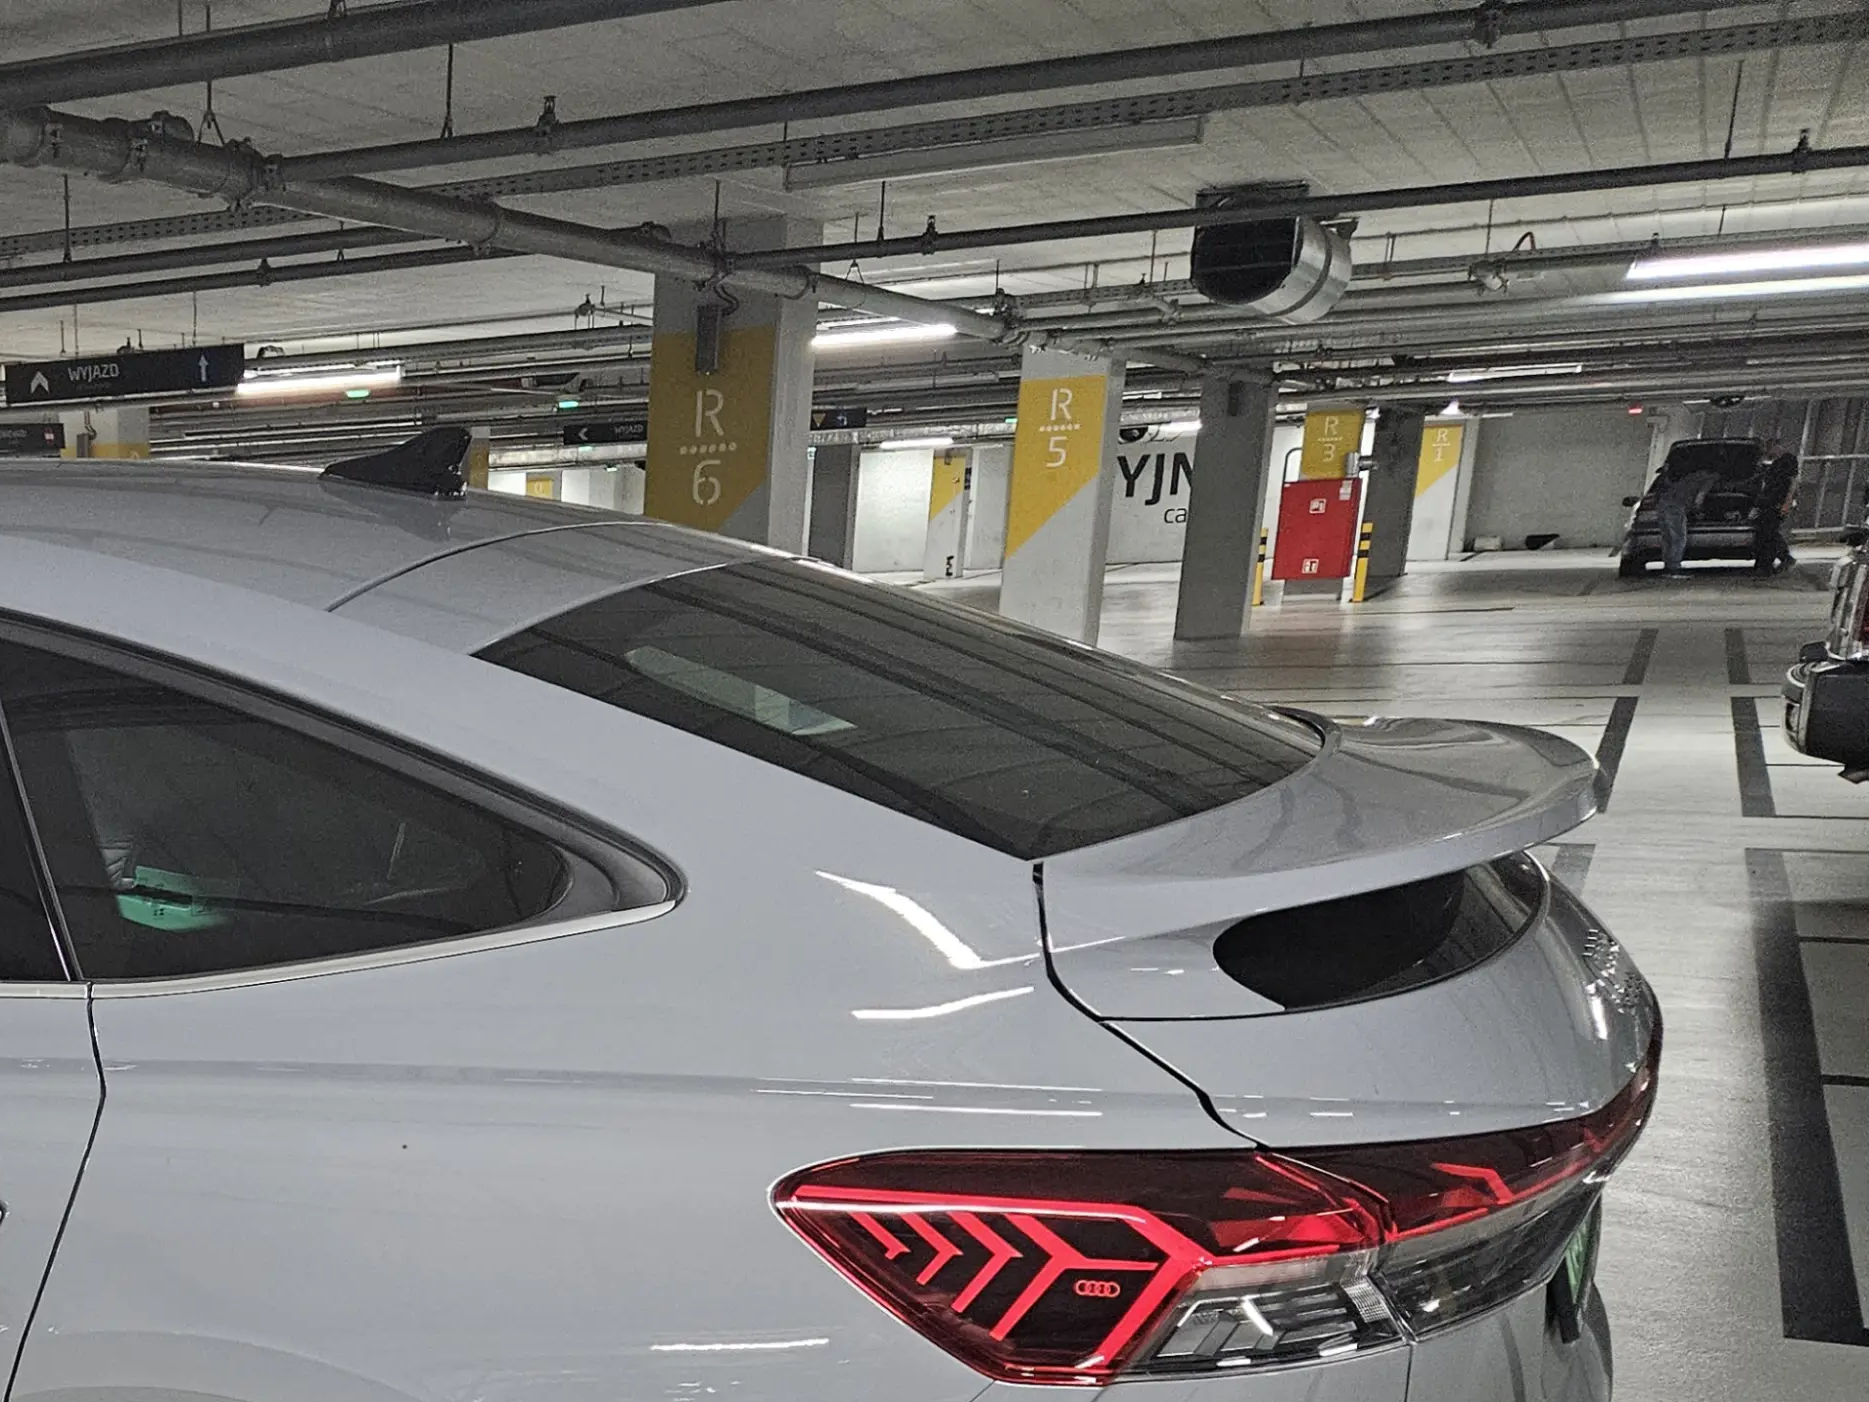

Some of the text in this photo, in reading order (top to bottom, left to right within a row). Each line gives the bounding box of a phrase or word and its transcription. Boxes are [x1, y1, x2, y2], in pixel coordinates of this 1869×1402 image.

[68, 363, 121, 382] WYJAZD
[694, 388, 725, 438] R
[1050, 387, 1073, 421] R
[1324, 415, 1339, 436] R
[1436, 428, 1449, 442] R
[1046, 435, 1069, 468] 5
[1322, 443, 1335, 462] 3
[691, 459, 722, 506] 6
